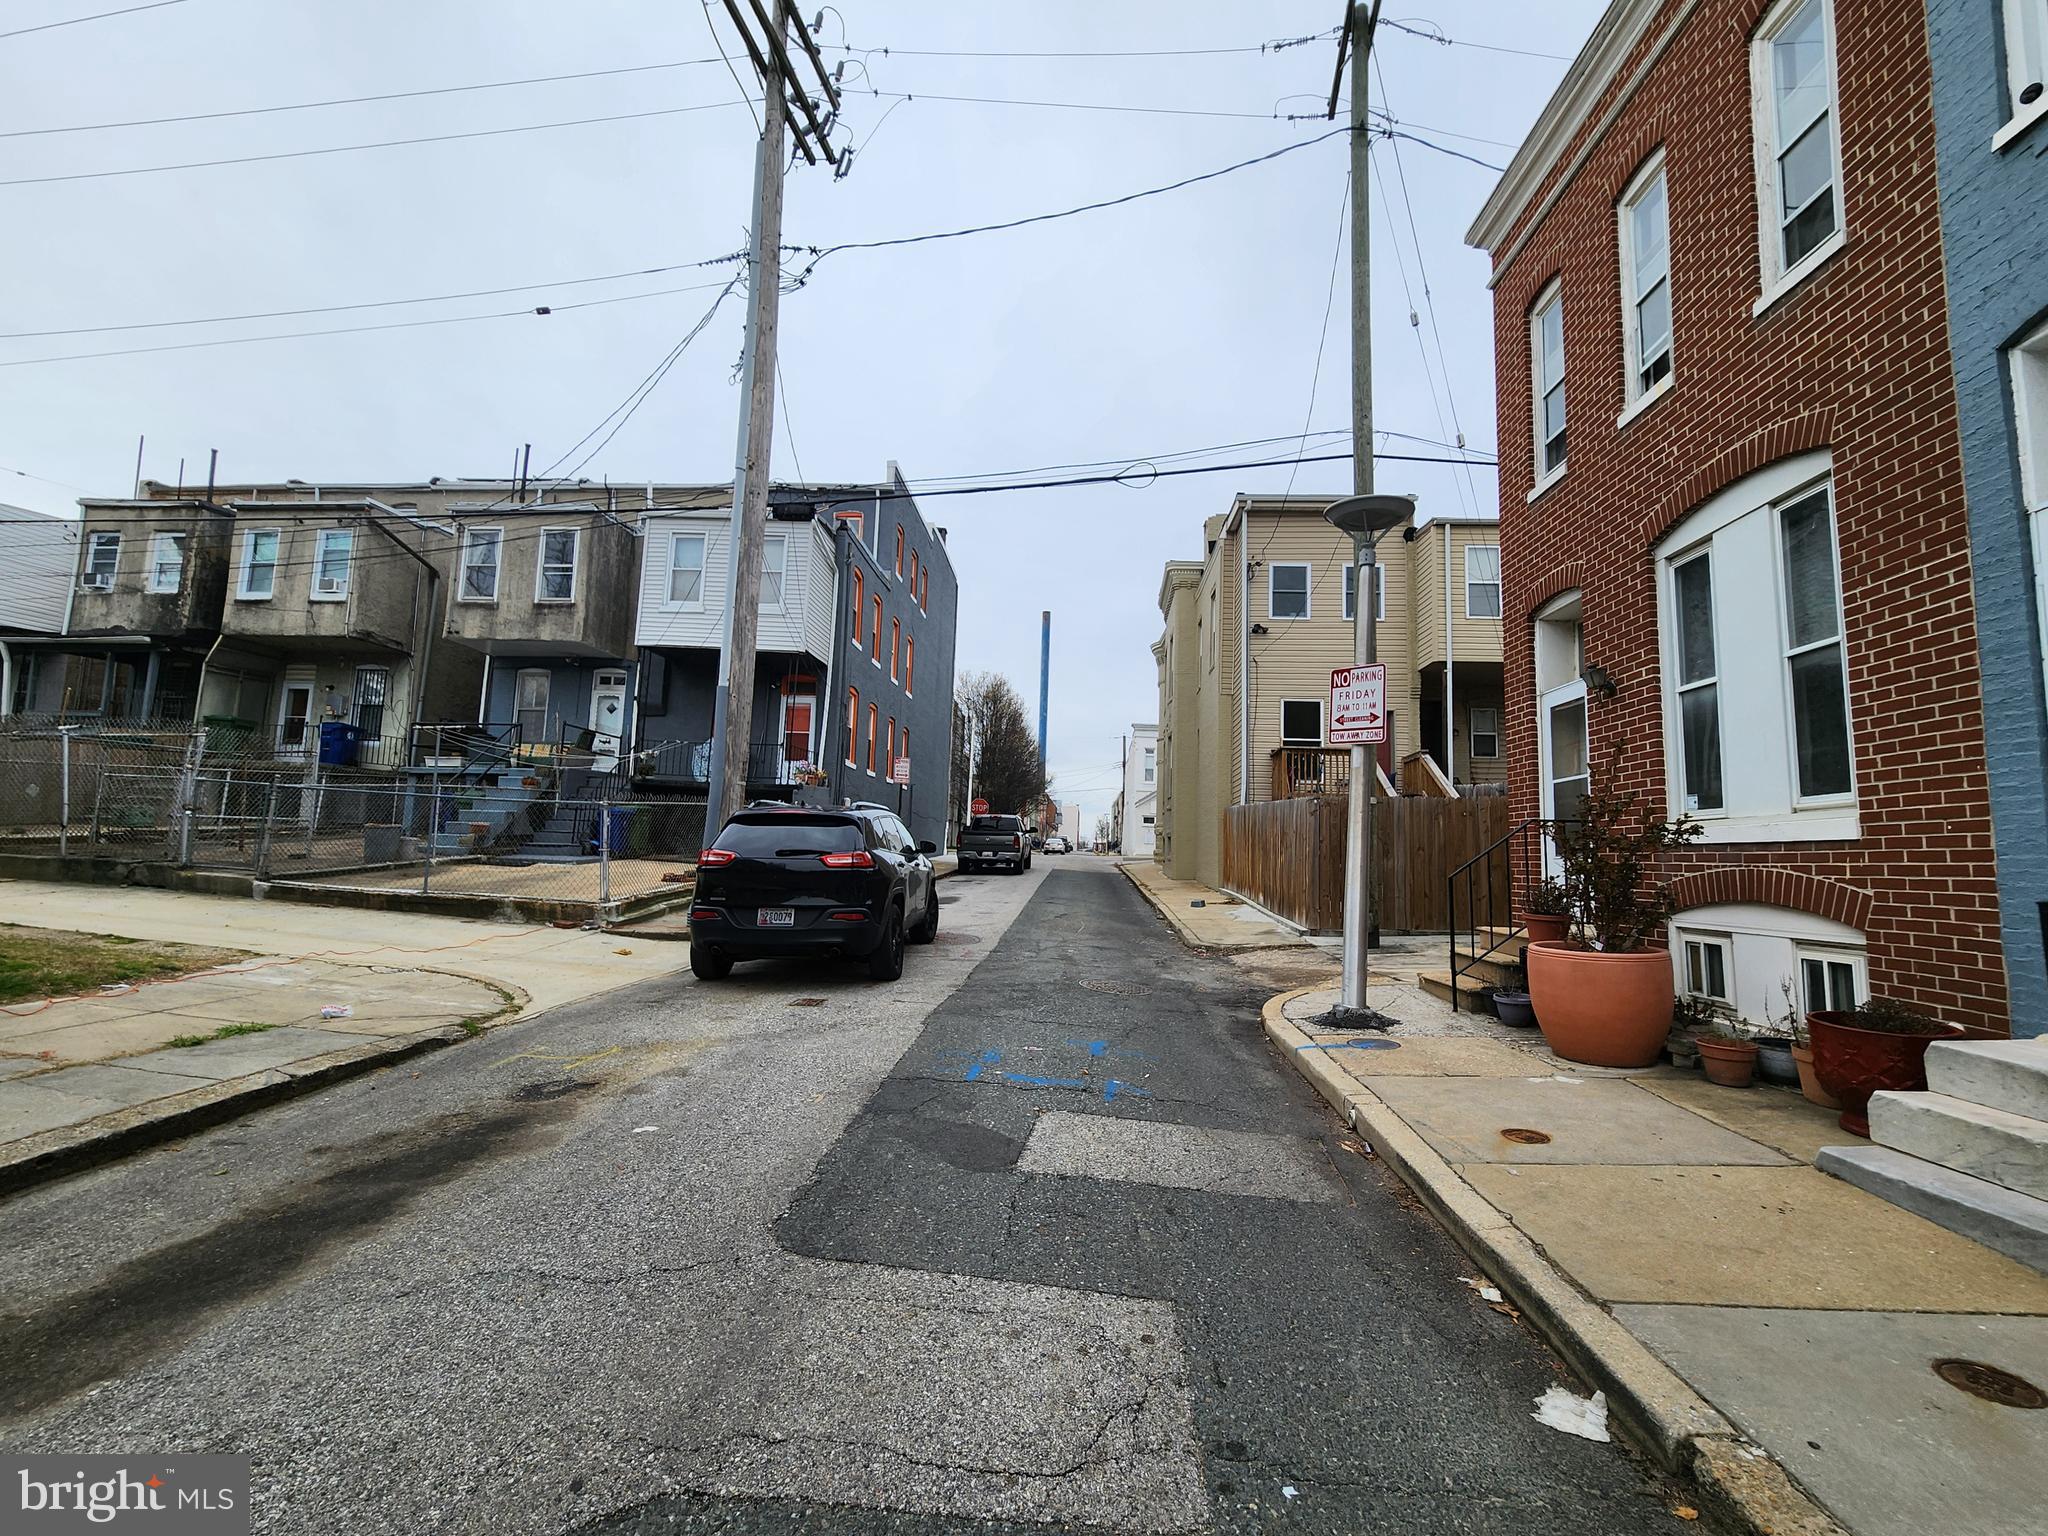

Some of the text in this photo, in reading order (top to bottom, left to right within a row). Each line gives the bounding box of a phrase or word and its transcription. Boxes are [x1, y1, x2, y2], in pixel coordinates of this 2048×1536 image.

[1333, 670, 1382, 687] NO PARKING
[1339, 689, 1376, 700] FRIDAY
[1337, 704, 1350, 712] 8AM
[1346, 732, 1364, 740] AWAY
[1365, 730, 1382, 738] ZONE
